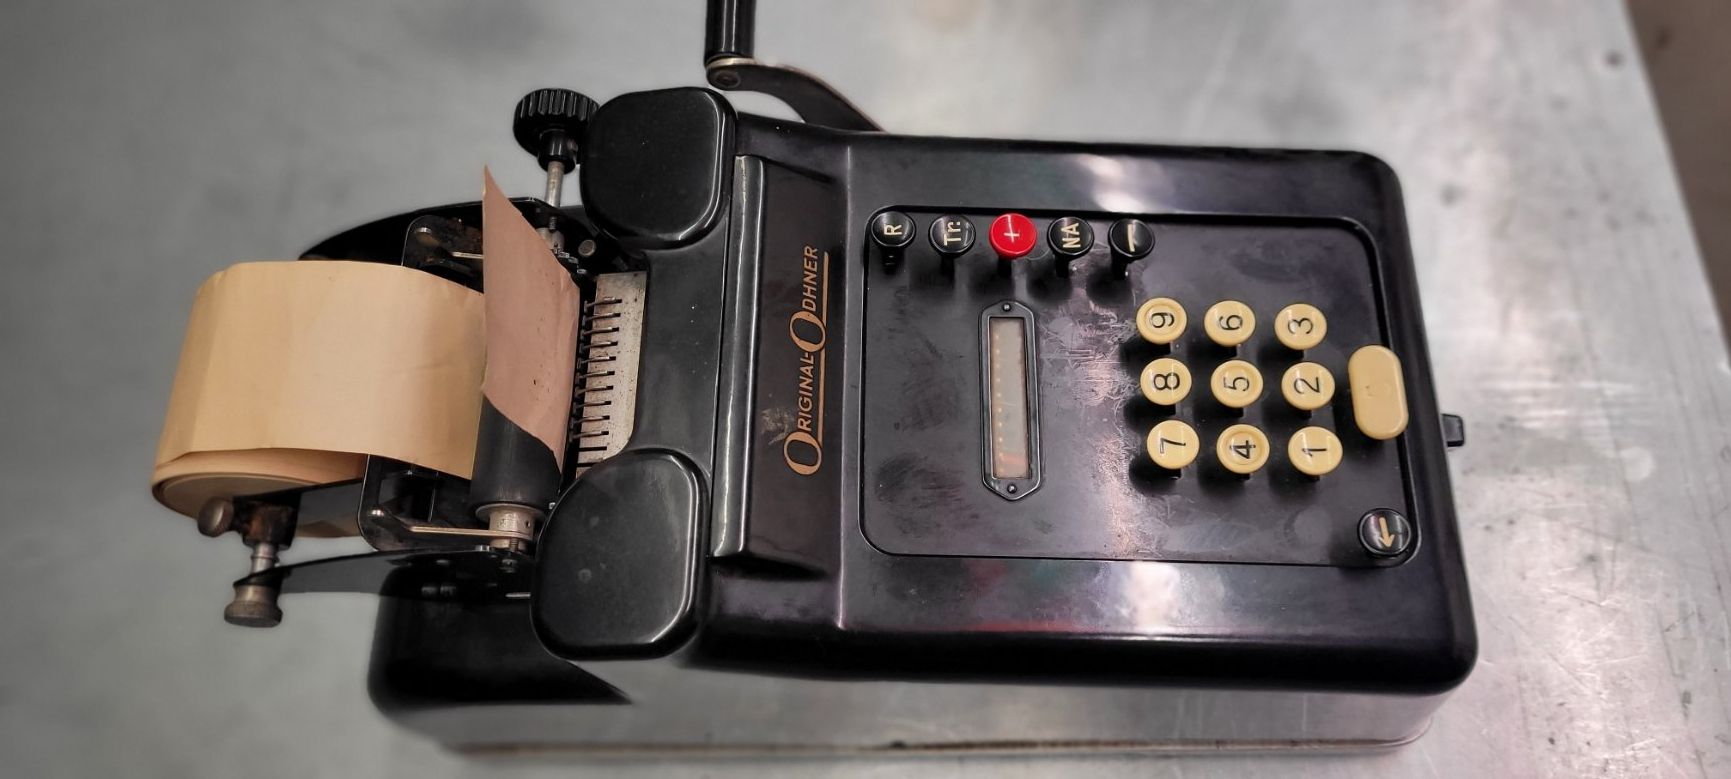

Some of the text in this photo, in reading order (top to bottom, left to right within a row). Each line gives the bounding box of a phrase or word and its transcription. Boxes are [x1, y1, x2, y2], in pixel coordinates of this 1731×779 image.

[883, 224, 903, 236] R
[1062, 222, 1082, 248] NA
[1150, 312, 1175, 329] 9
[1218, 314, 1243, 331] 6
[1287, 317, 1314, 335] 3
[1153, 372, 1181, 391] 8
[1223, 376, 1250, 392] 5
[1293, 376, 1321, 394] 2
[1159, 437, 1187, 454] 7
[1229, 439, 1256, 459] 4
[1301, 447, 1327, 457] 1
